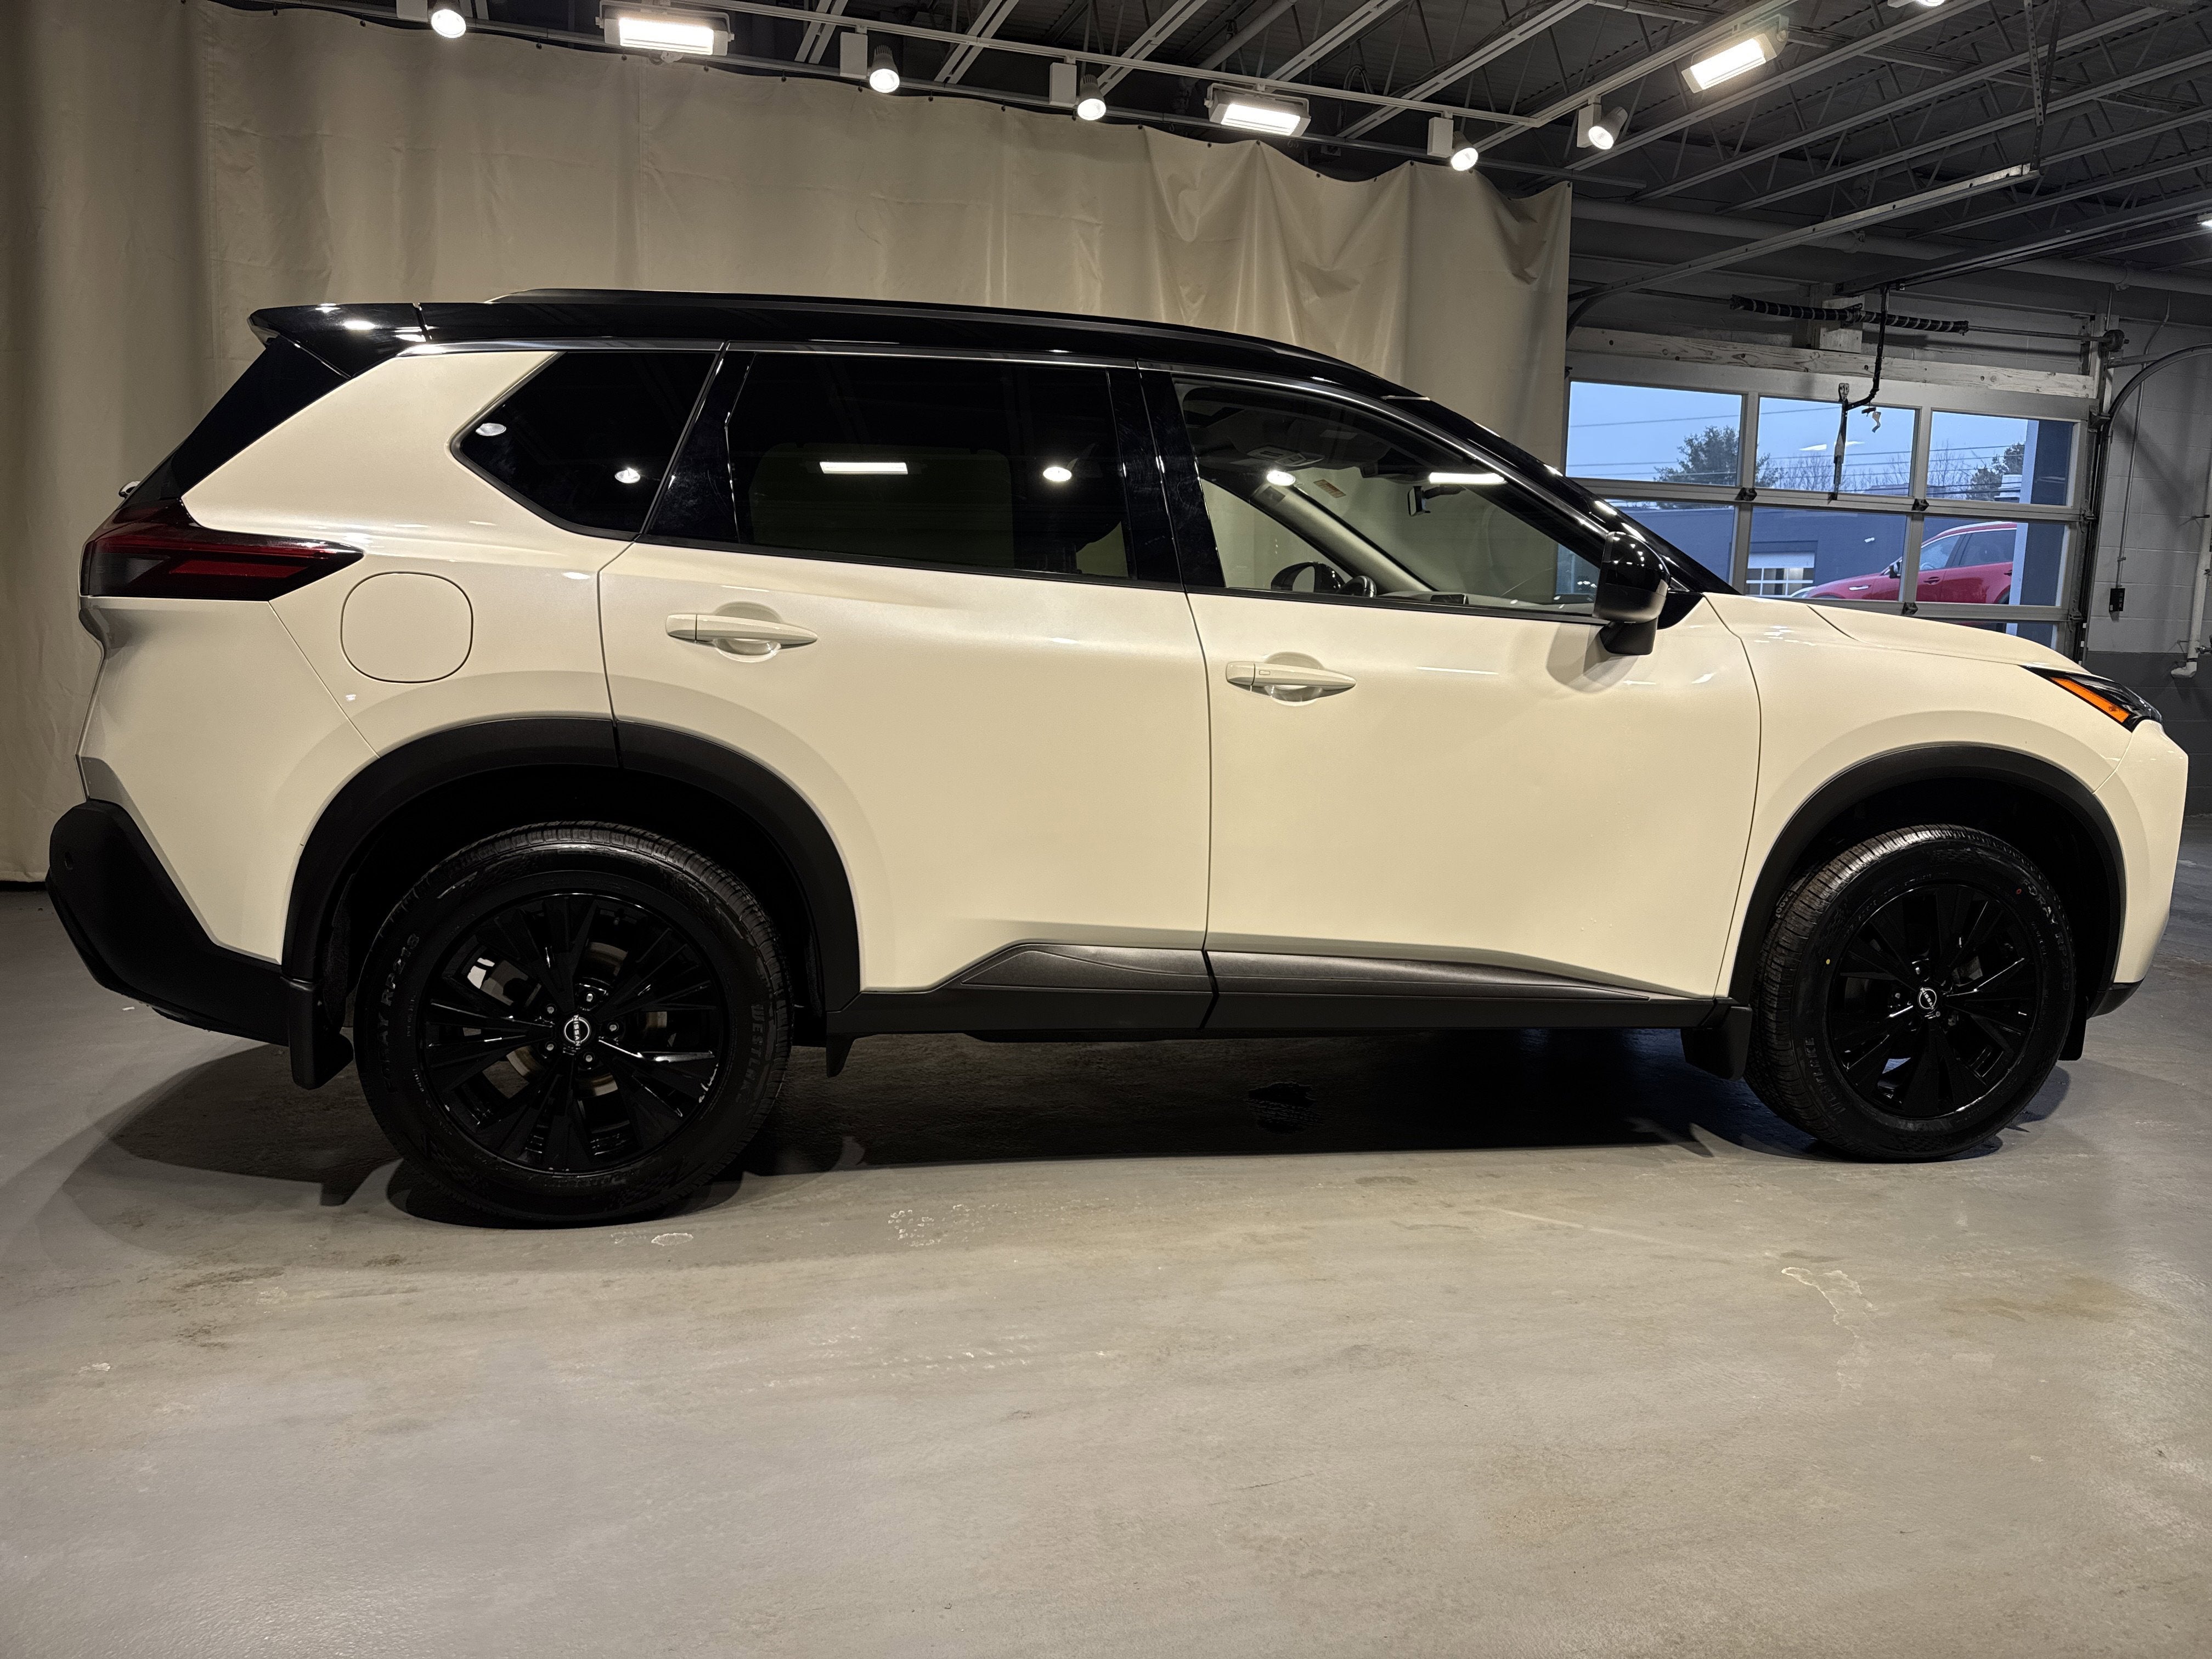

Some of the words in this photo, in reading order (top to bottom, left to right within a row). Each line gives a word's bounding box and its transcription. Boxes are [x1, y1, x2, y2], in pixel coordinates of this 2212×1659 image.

[2023, 879, 2058, 924] FORAY
[2055, 932, 2070, 991] RP28
[380, 932, 420, 1007] RP218
[1920, 987, 1935, 1010] NISSAN
[573, 1014, 582, 1047] NISSAN
